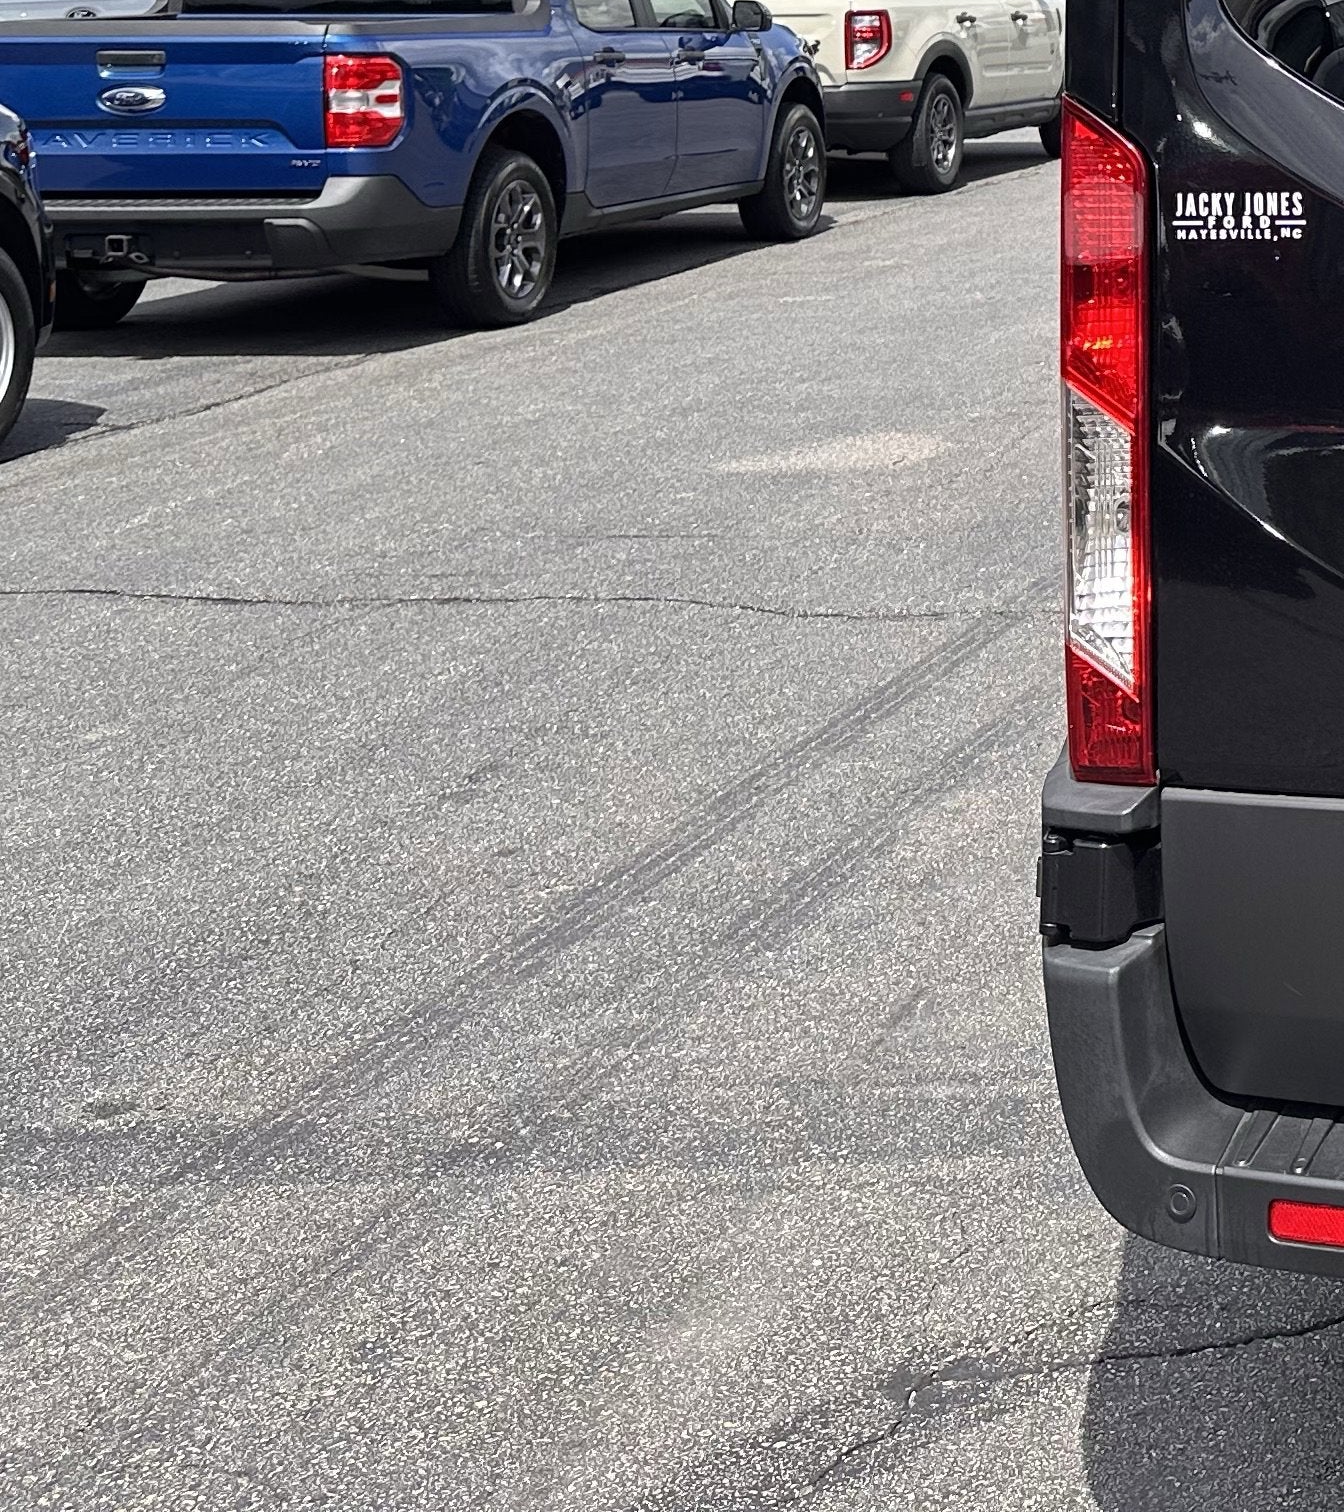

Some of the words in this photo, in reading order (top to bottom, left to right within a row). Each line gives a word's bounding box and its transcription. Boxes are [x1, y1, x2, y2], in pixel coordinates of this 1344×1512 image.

[42, 131, 270, 148] AVERICK
[1175, 192, 1235, 217] JACKY
[1244, 191, 1303, 217] JONES
[1207, 215, 1271, 230] FORD
[1280, 227, 1303, 239] NC
